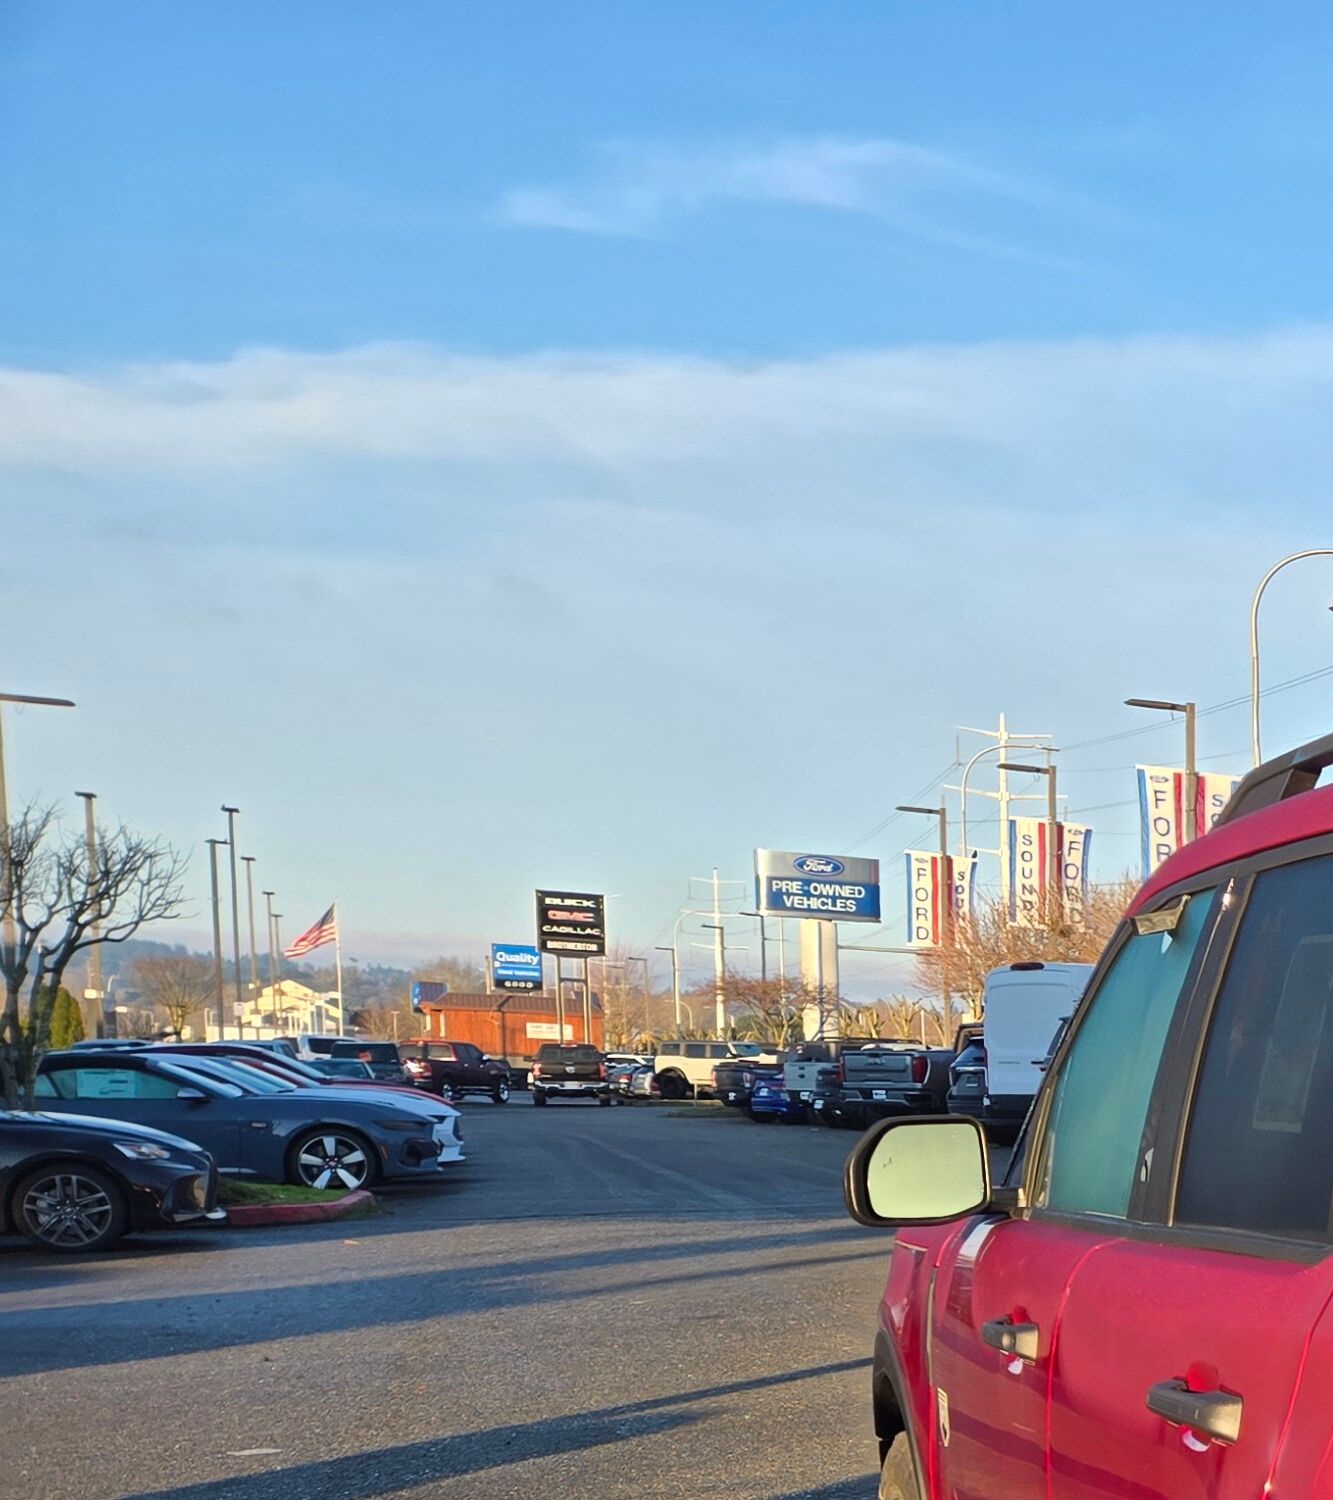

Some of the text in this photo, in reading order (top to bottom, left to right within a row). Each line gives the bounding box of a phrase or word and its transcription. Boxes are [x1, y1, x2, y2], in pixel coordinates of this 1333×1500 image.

[1153, 789, 1172, 863] FOR
[802, 858, 834, 873] Ford
[771, 880, 866, 899] PRE-OWNED
[544, 897, 597, 908] BUICK
[782, 895, 857, 912] VEHICLES
[915, 867, 930, 941] FORD
[547, 910, 595, 922] GMC
[542, 925, 601, 936] CADILLAC
[495, 951, 540, 966] Quality
